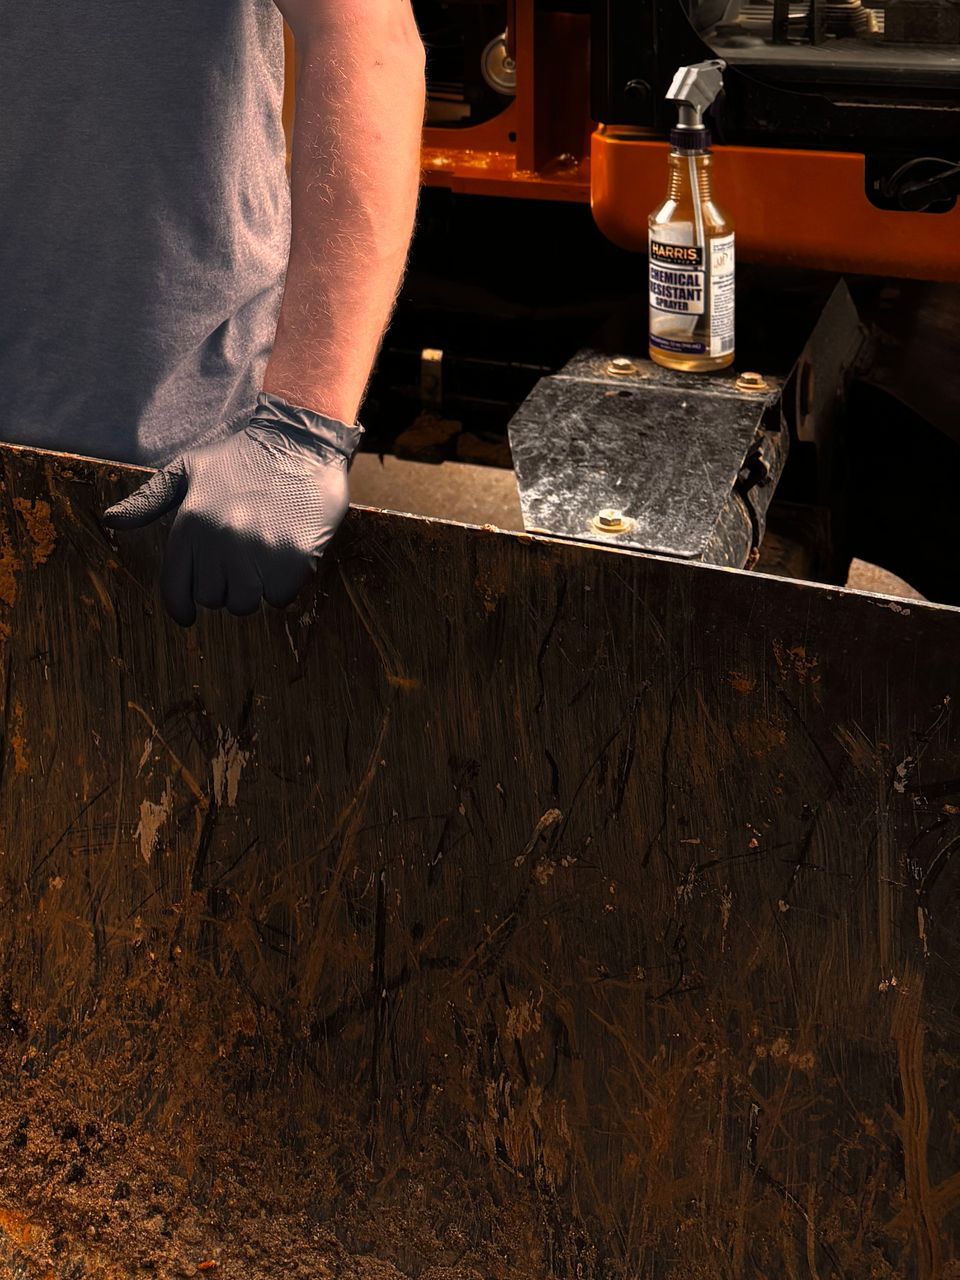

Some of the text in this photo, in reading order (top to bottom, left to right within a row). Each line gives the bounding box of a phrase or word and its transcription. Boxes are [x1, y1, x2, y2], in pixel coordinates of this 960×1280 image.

[652, 243, 697, 261] HARRIS
[651, 268, 700, 287] CHEMICAL
[649, 282, 702, 301] RESISTANT
[656, 297, 689, 311] SPRAYER
